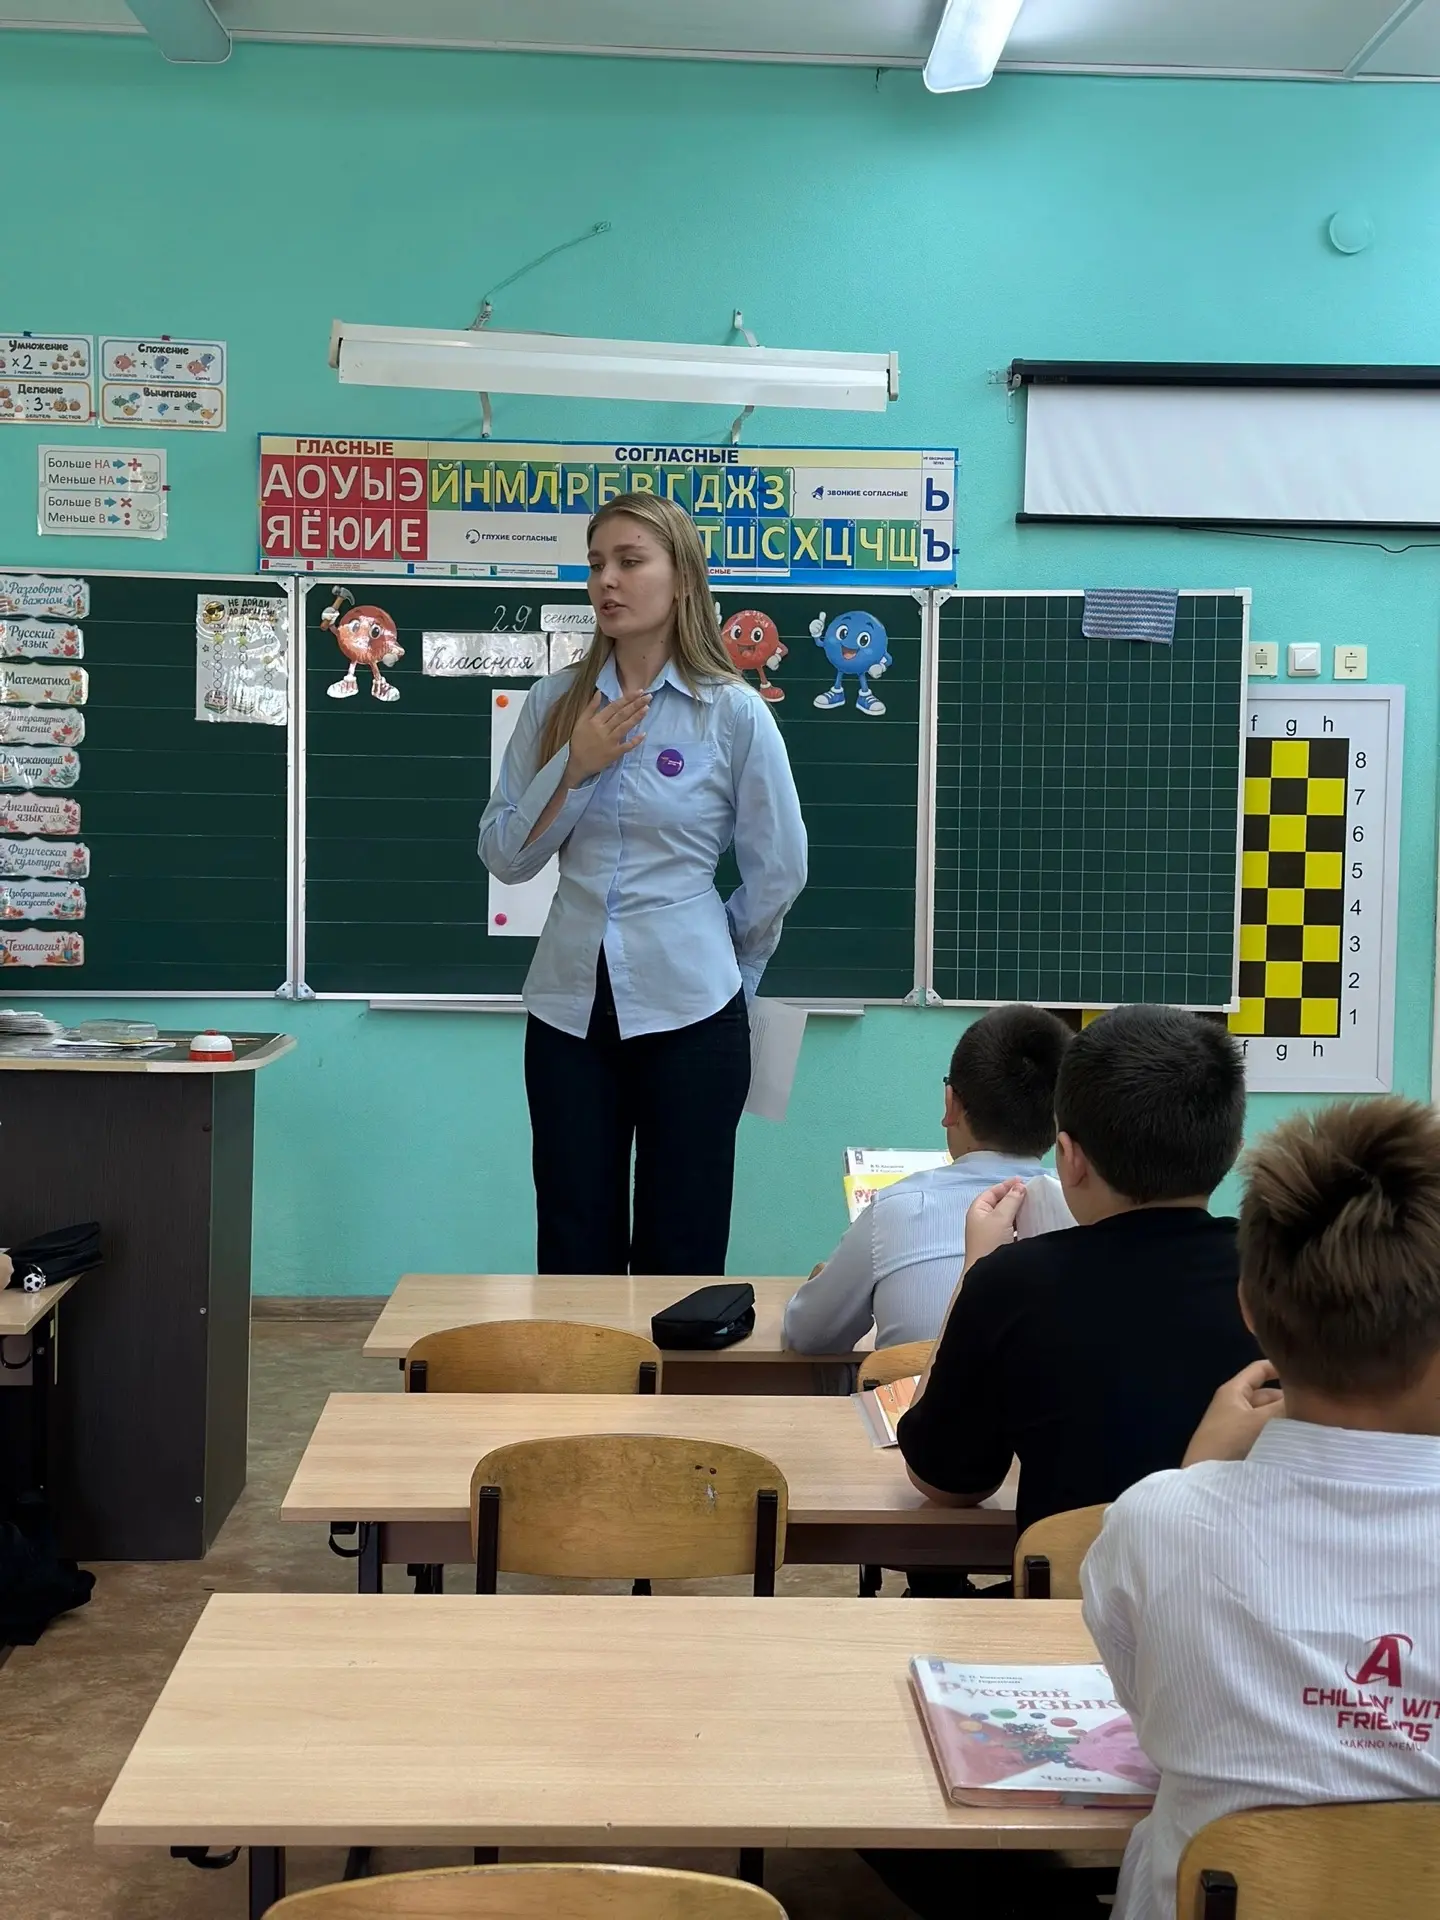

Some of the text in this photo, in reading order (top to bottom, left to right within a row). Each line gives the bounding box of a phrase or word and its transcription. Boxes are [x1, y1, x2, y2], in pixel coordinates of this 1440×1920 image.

[9, 340, 69, 352] Умножение
[138, 343, 190, 355] Сложение
[17, 384, 64, 395] Деление
[143, 387, 197, 398] Вычитание
[296, 439, 394, 456] ГЛАСНЫЕ
[615, 447, 739, 463] СОГЛАСНЫЕ
[48, 458, 110, 469] Больше НА
[48, 475, 115, 485] Меньше НА
[48, 497, 102, 507] Больше В
[925, 477, 950, 512] Ь
[48, 513, 106, 524] Меньше В
[511, 534, 557, 542] СОГЛАСНЫЕ
[923, 529, 951, 562] Ъ
[8, 581, 63, 597] Разговоры
[22, 595, 63, 605] важном
[228, 598, 270, 608] НЕ ДОЙДИ
[9, 625, 56, 641] Русский
[21, 639, 49, 649] язык
[427, 646, 534, 674] Классная
[4, 671, 71, 686] Математика
[17, 726, 52, 734] чтение
[1251, 714, 1333, 736] f g h
[1355, 751, 1366, 768] 8
[1354, 789, 1366, 805] 7
[1, 800, 60, 814] Английский
[16, 814, 44, 823] язык
[1353, 826, 1364, 842] 6
[8, 844, 67, 857] Физическая
[15, 858, 61, 870] культура
[1351, 862, 1363, 879] 5
[1350, 899, 1361, 915] 4
[5, 939, 60, 951] Технология
[1349, 935, 1360, 952] 3
[1348, 972, 1359, 989] 2
[1349, 1009, 1357, 1025] 1
[1242, 1040, 1323, 1061] f g h
[938, 1681, 1072, 1698] Русский
[1402, 1697, 1440, 1719] WIT
